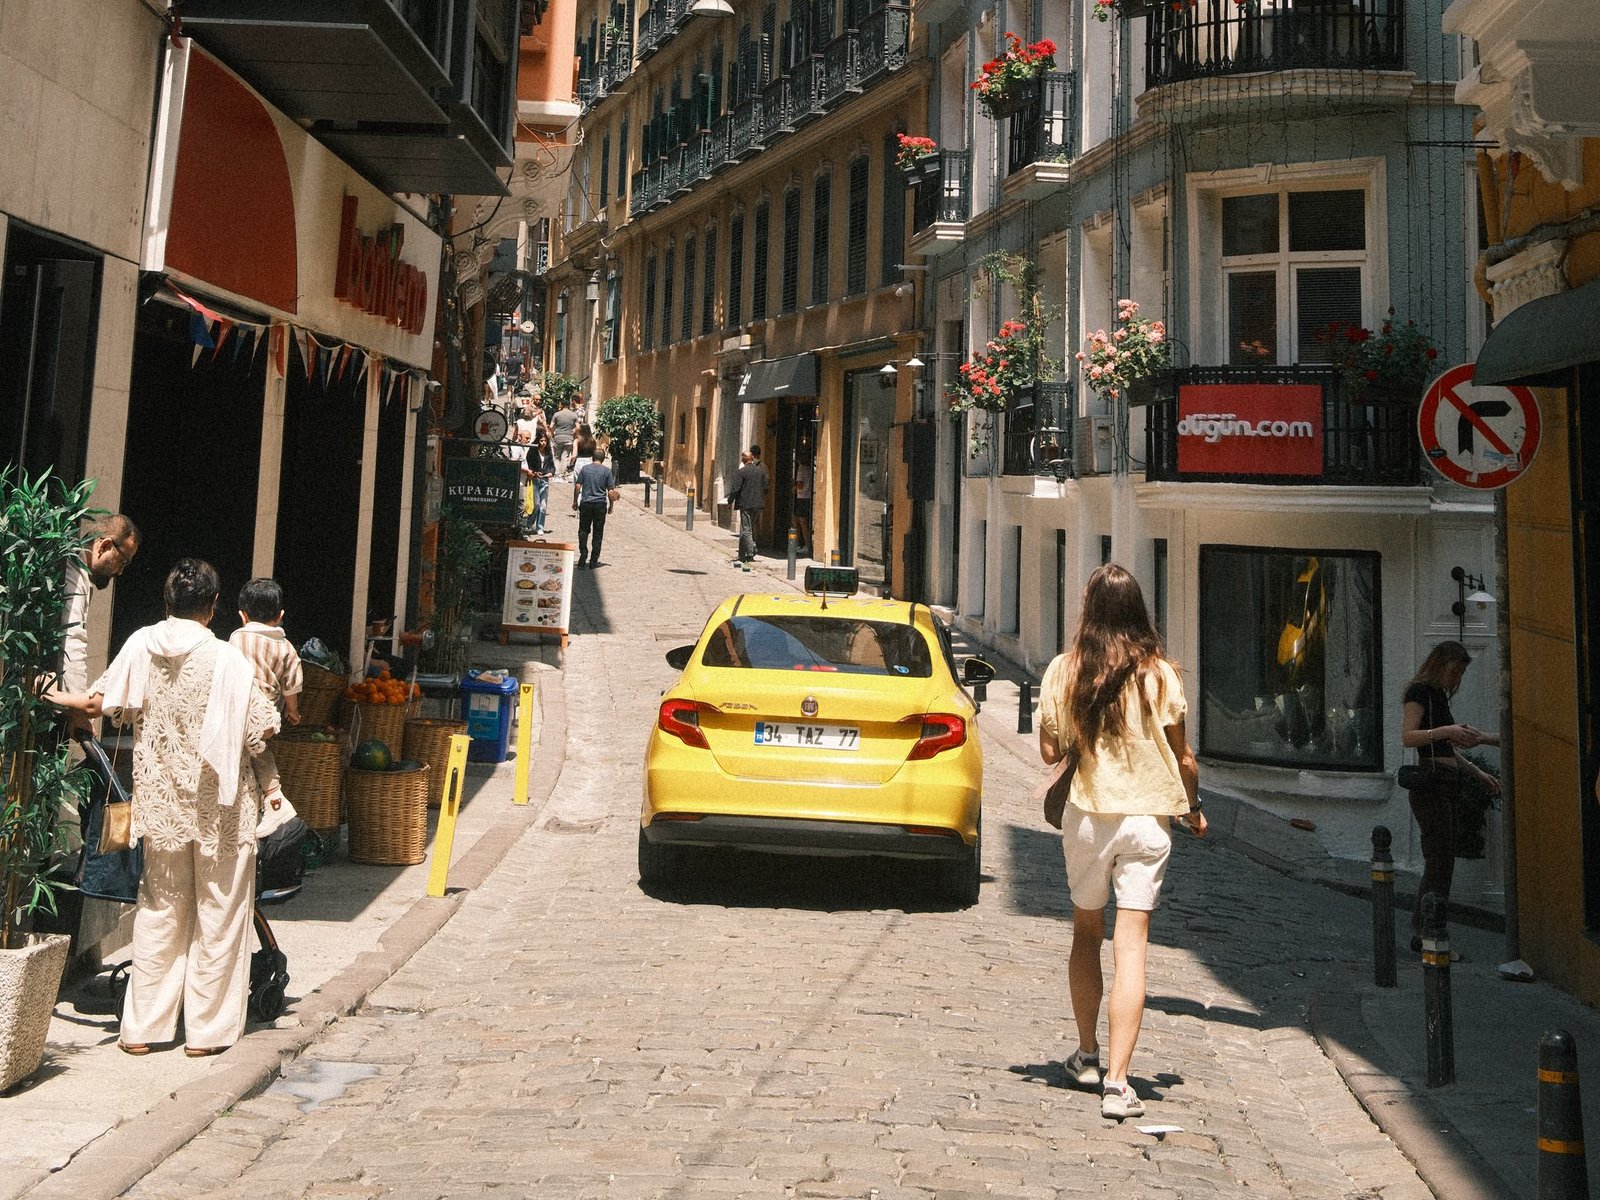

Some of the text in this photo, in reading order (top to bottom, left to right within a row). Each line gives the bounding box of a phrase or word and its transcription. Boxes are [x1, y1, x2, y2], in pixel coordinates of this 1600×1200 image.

[448, 485, 481, 496] KUPA
[764, 725, 782, 743] 34
[796, 726, 824, 745] TAZ
[838, 728, 858, 747] 77
